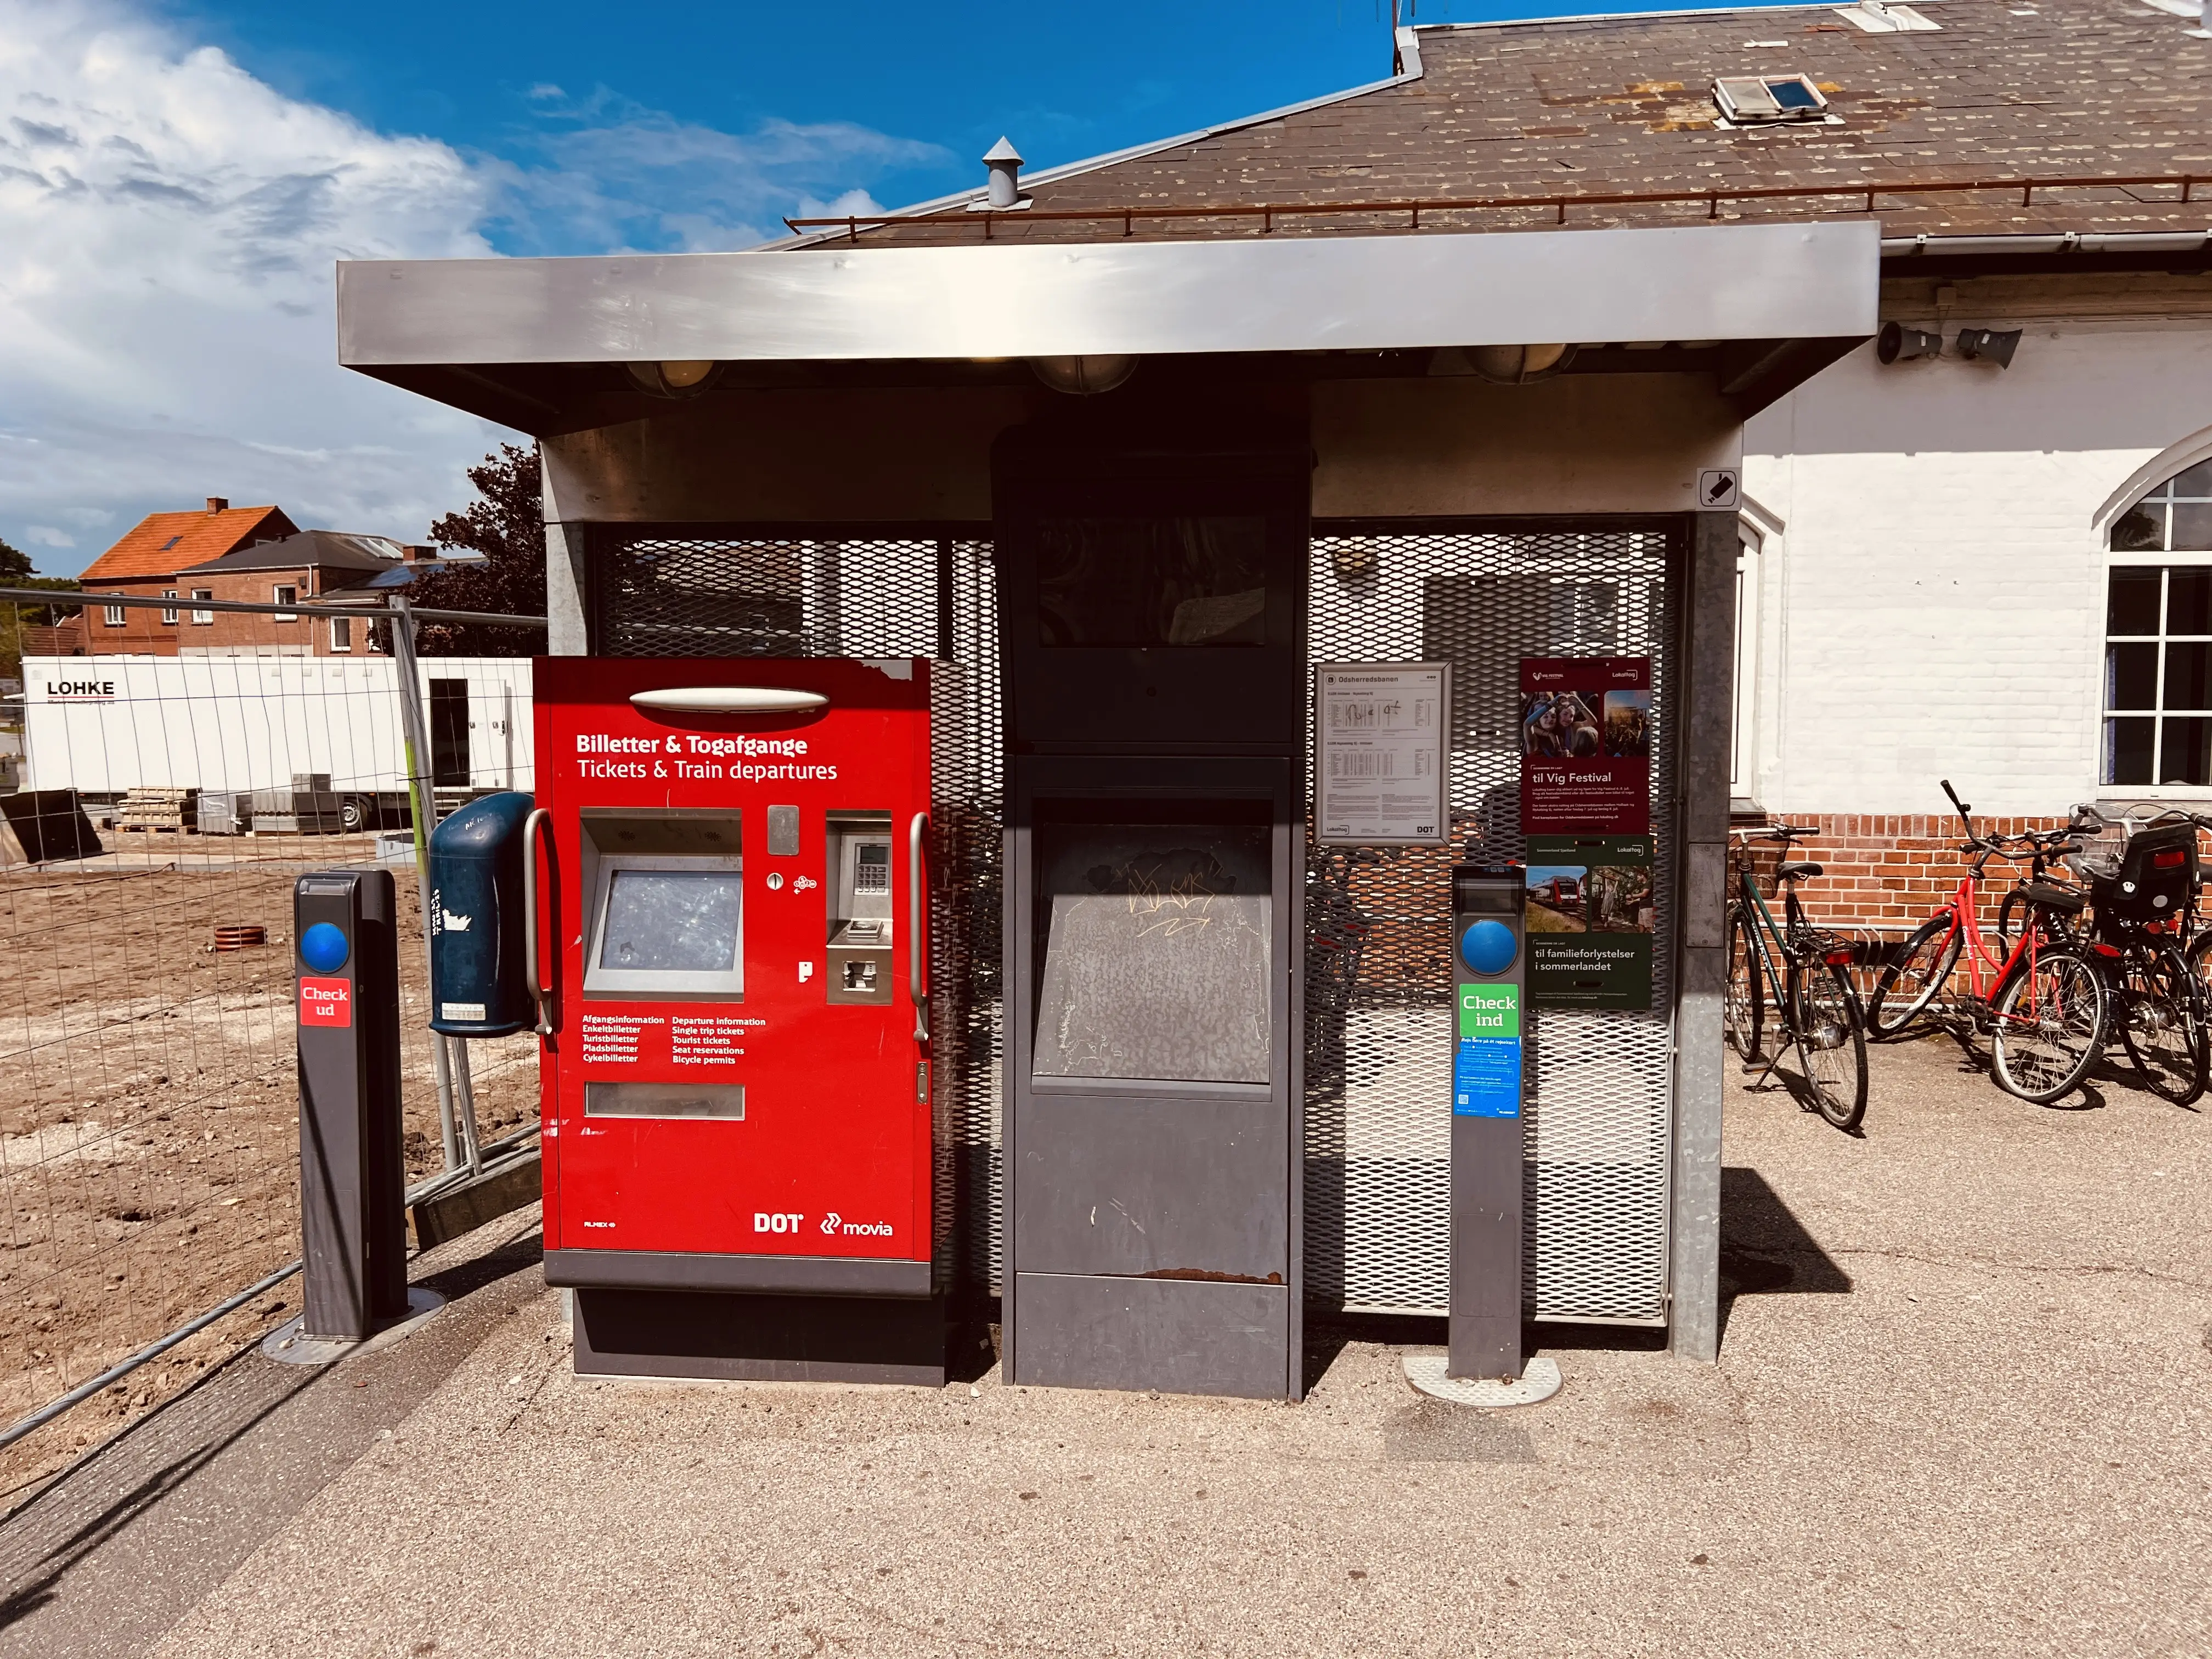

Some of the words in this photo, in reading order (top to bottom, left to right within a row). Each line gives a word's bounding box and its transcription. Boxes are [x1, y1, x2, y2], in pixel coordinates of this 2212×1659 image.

[47, 681, 114, 695] LOHKE
[576, 734, 659, 753] Billetter
[665, 735, 681, 754] &
[686, 735, 808, 758] Togafgange
[577, 759, 646, 778] Tickets
[653, 760, 668, 778] &
[674, 760, 723, 779] Train
[729, 760, 837, 783] departures
[1532, 773, 1543, 783] til
[1547, 773, 1566, 785] Vig
[1569, 772, 1611, 782] Festival
[1535, 949, 1545, 958] til
[1547, 949, 1635, 960] familieforlystelser
[1535, 962, 1538, 970] i
[1541, 961, 1611, 970] sommerlandet
[302, 986, 348, 1001] Check
[1463, 995, 1516, 1009] Check
[315, 1003, 335, 1016] ud
[582, 1014, 664, 1024] Afgangsinformation
[672, 1016, 714, 1026] Departure
[716, 1017, 766, 1025] information
[1476, 1013, 1503, 1026] ind
[583, 1024, 641, 1034] Enkeltbilletter
[672, 1026, 698, 1035] Single
[699, 1027, 715, 1036] trip
[716, 1026, 744, 1035] tickets
[582, 1034, 639, 1043] Turistbilletter
[672, 1036, 701, 1044] Tourist
[703, 1036, 731, 1045] tickets
[583, 1044, 639, 1053] Pladsbilletter
[693, 1046, 744, 1055] reservations
[583, 1053, 639, 1063] Cykelbilletter
[673, 1055, 702, 1065] Bicycle
[703, 1056, 736, 1065] permits
[754, 1212, 803, 1233] DOT
[843, 1221, 893, 1236] movia
